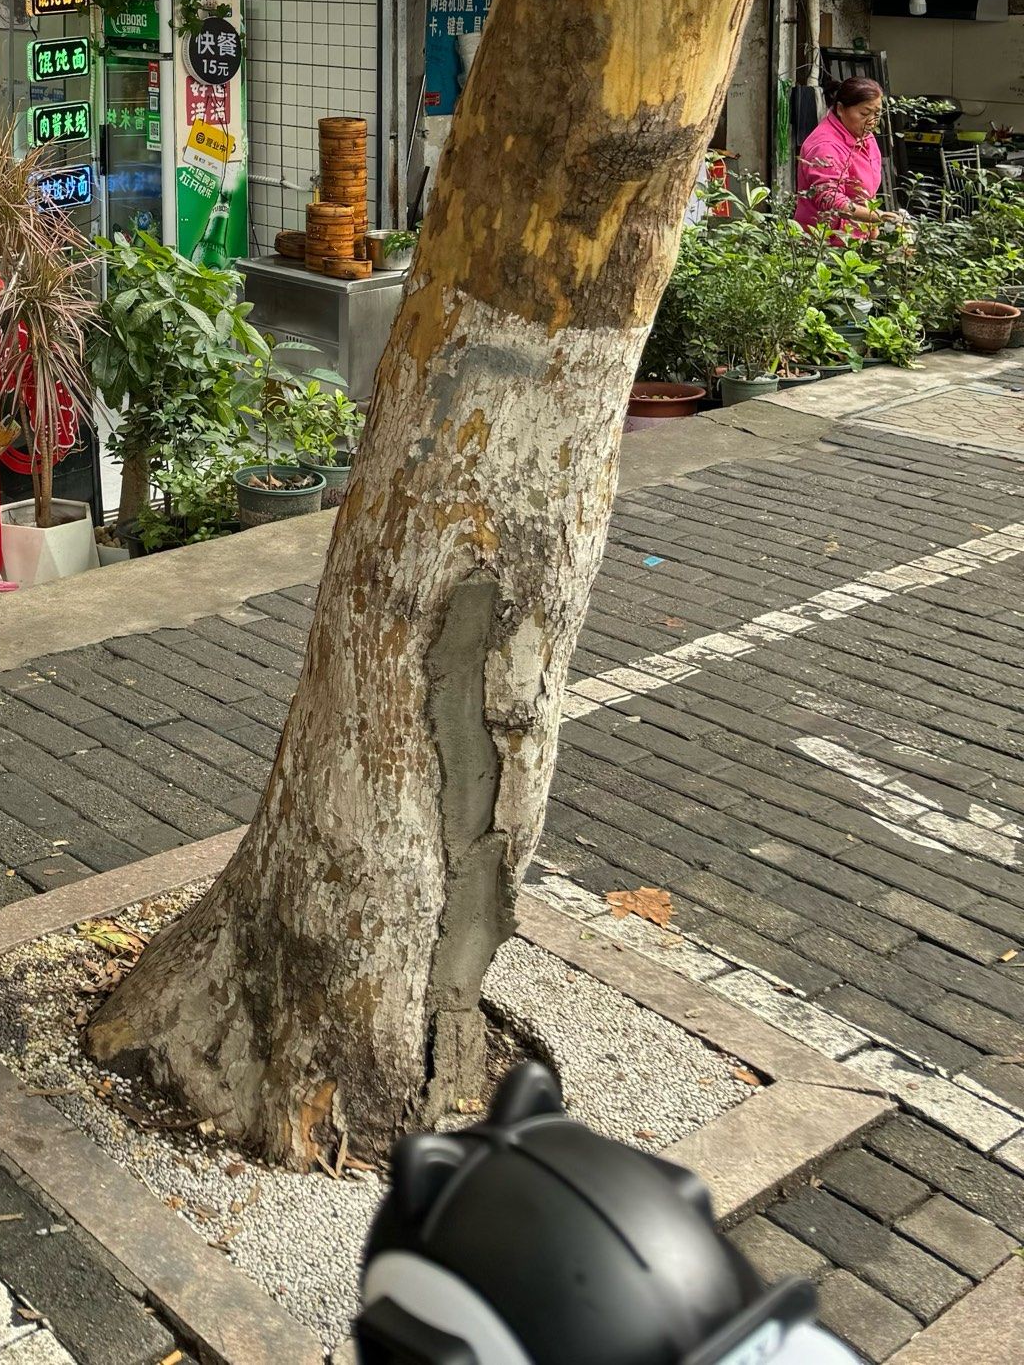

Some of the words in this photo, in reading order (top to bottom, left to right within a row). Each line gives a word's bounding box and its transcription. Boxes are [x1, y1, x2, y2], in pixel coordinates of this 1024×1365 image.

[116, 13, 147, 27] TUBORG
[195, 30, 237, 57] 快餐
[38, 47, 85, 73] 馄饨面
[202, 59, 229, 76] 15元
[39, 110, 87, 138] 肉酱米线
